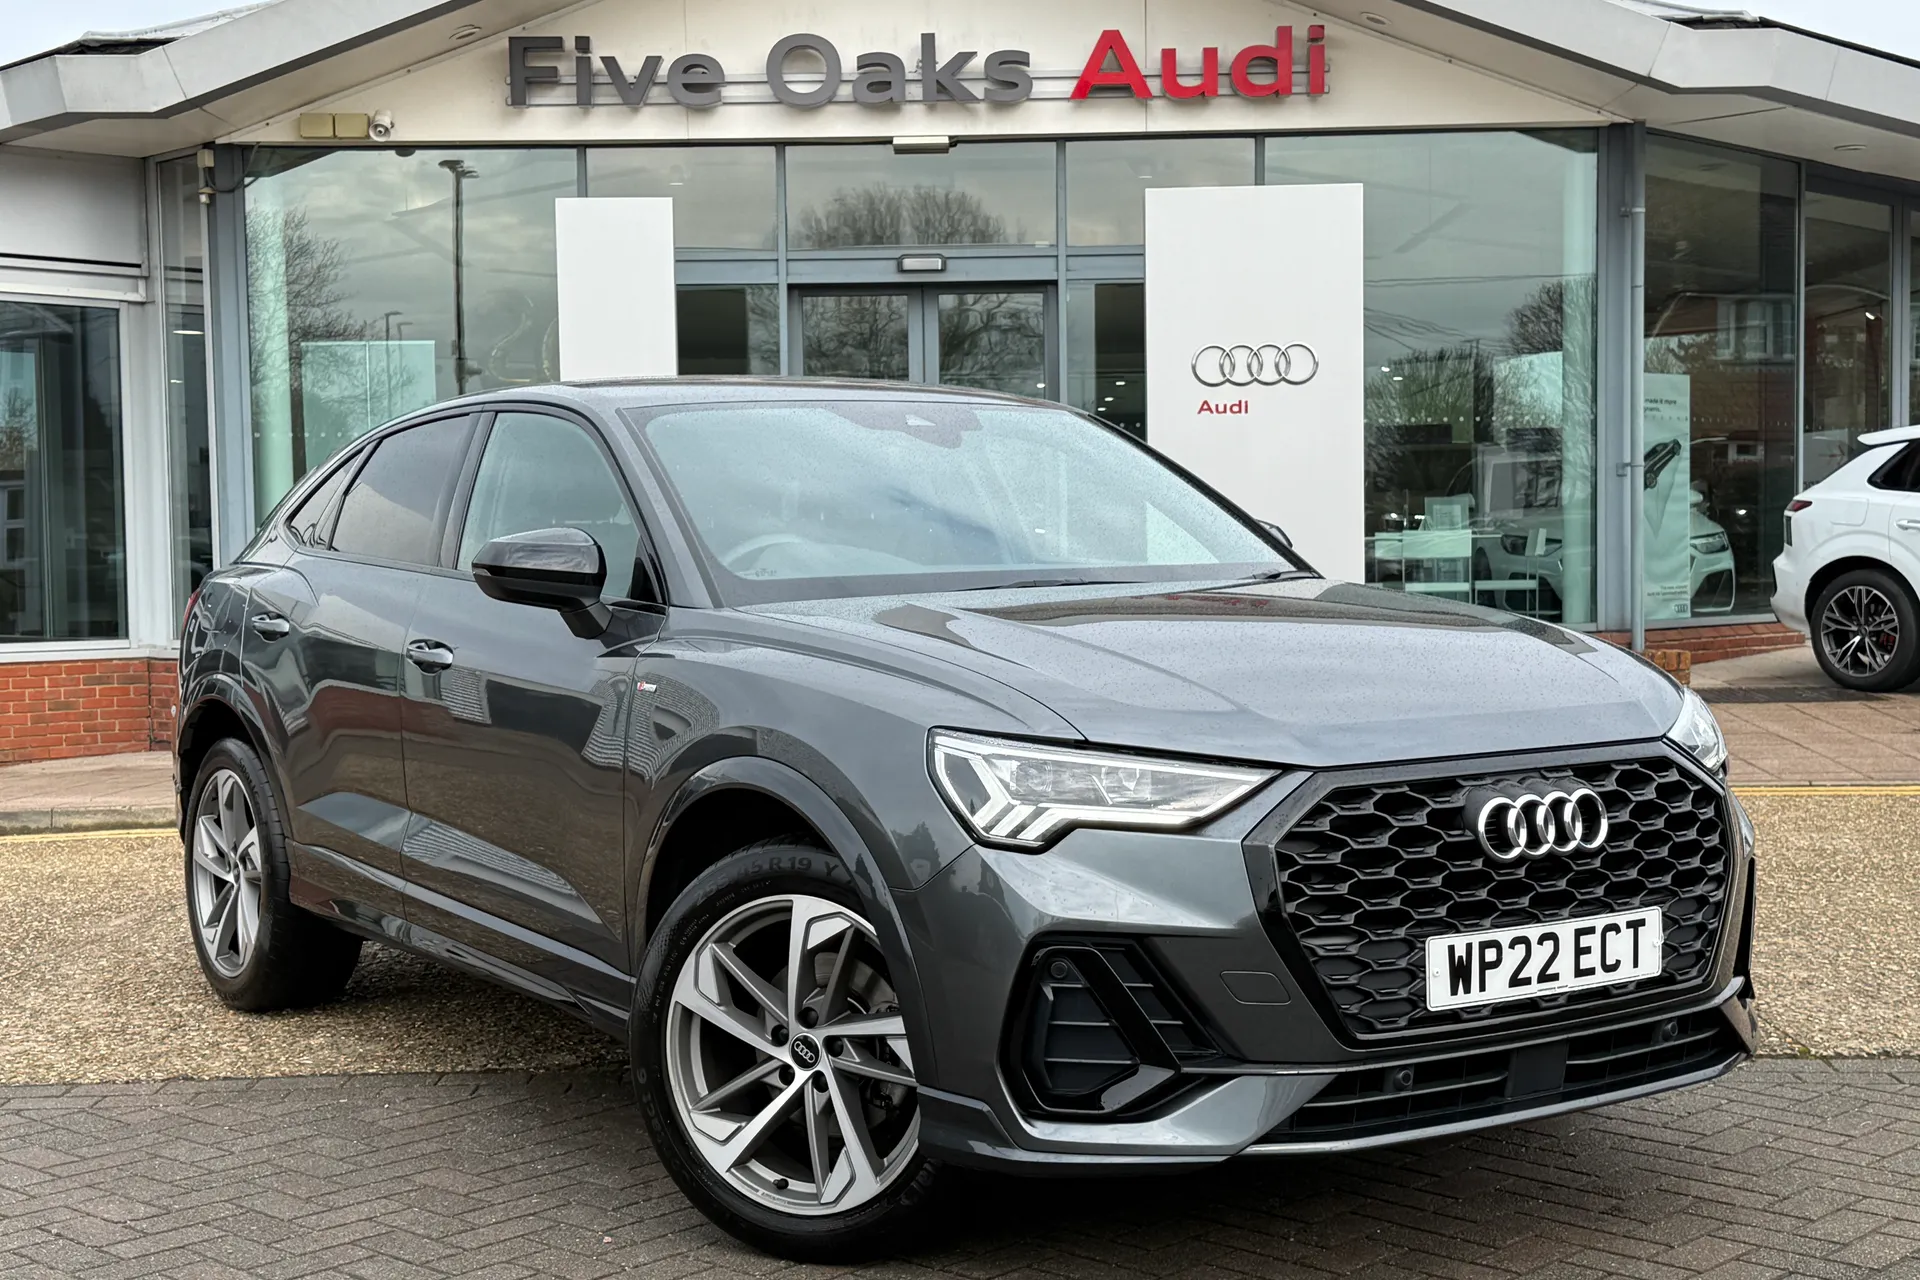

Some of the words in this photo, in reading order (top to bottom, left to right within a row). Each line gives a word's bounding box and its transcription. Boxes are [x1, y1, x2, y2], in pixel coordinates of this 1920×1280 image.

[508, 36, 726, 108] Five
[766, 33, 1033, 108] Oaks
[1070, 25, 1325, 100] Audi
[1197, 399, 1249, 415] Audi
[1448, 931, 1560, 997] WP22
[1573, 917, 1646, 979] ECT
